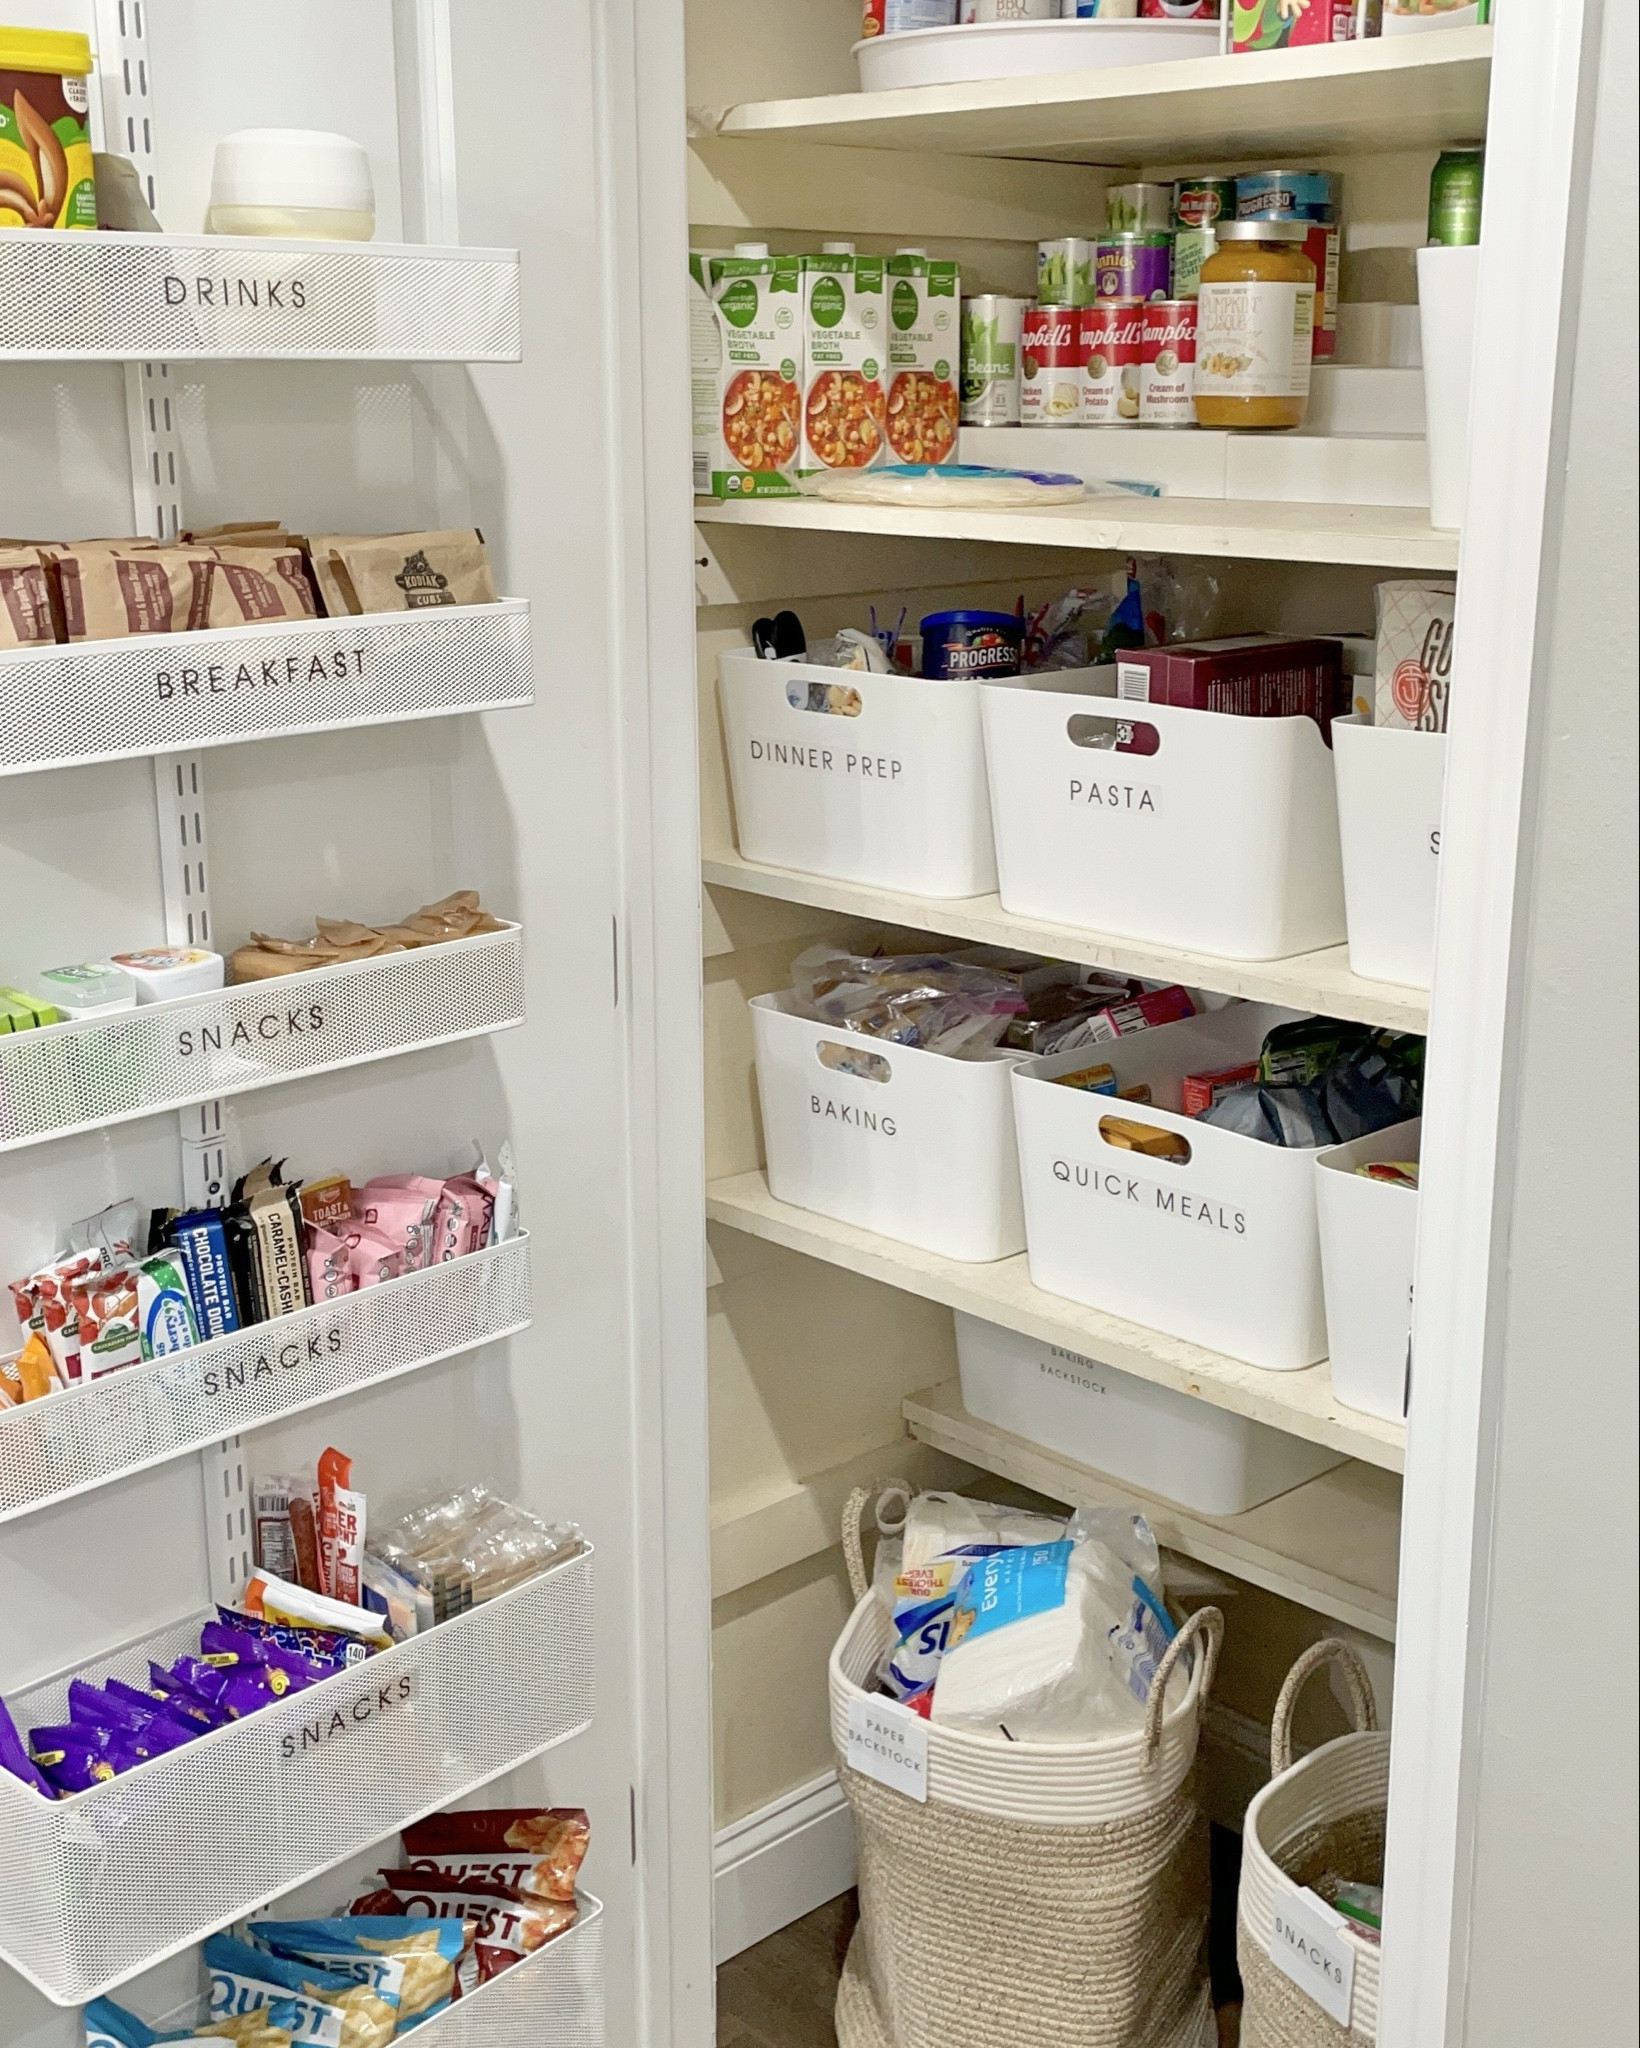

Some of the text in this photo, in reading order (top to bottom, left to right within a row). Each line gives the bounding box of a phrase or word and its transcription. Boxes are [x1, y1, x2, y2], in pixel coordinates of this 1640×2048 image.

[164, 276, 307, 309] DRINKS
[726, 329, 776, 340] VEGETABLE
[727, 341, 756, 350] BROTH
[811, 331, 861, 340] VEGETABLE
[811, 342, 840, 350] BROTH
[967, 358, 1010, 373] Beans
[1146, 395, 1190, 403] Mushroom
[1149, 384, 1174, 392] Cream
[1176, 383, 1186, 393] of
[404, 575, 440, 588] KODIAK
[416, 594, 442, 605] CUBS
[950, 647, 1017, 668] PROGRESS
[157, 649, 367, 700] BREAKFAST
[751, 740, 902, 781] DINNER PREP
[1070, 780, 1155, 812] PASTA
[179, 1004, 325, 1056] SNACKS
[811, 1095, 896, 1136] BAKING
[313, 1202, 342, 1221] TOAST
[1053, 1161, 1246, 1234] QUICK MEALS
[192, 1227, 220, 1306] CHOCOLATE
[287, 1237, 298, 1278] PROTEIN
[214, 1254, 233, 1320] PROTEIN BAR
[204, 1329, 342, 1396] SNACKS
[1051, 1347, 1094, 1370] BAKING
[1040, 1363, 1107, 1395] BACKSTOCK
[349, 1646, 364, 1660] 140
[282, 1676, 411, 1758] SNACKS
[867, 1719, 905, 1744] PAPER
[849, 1729, 921, 1773] BACKSTOCK
[1276, 1917, 1342, 1985] SNACKS
[208, 1974, 332, 2034] QUST
